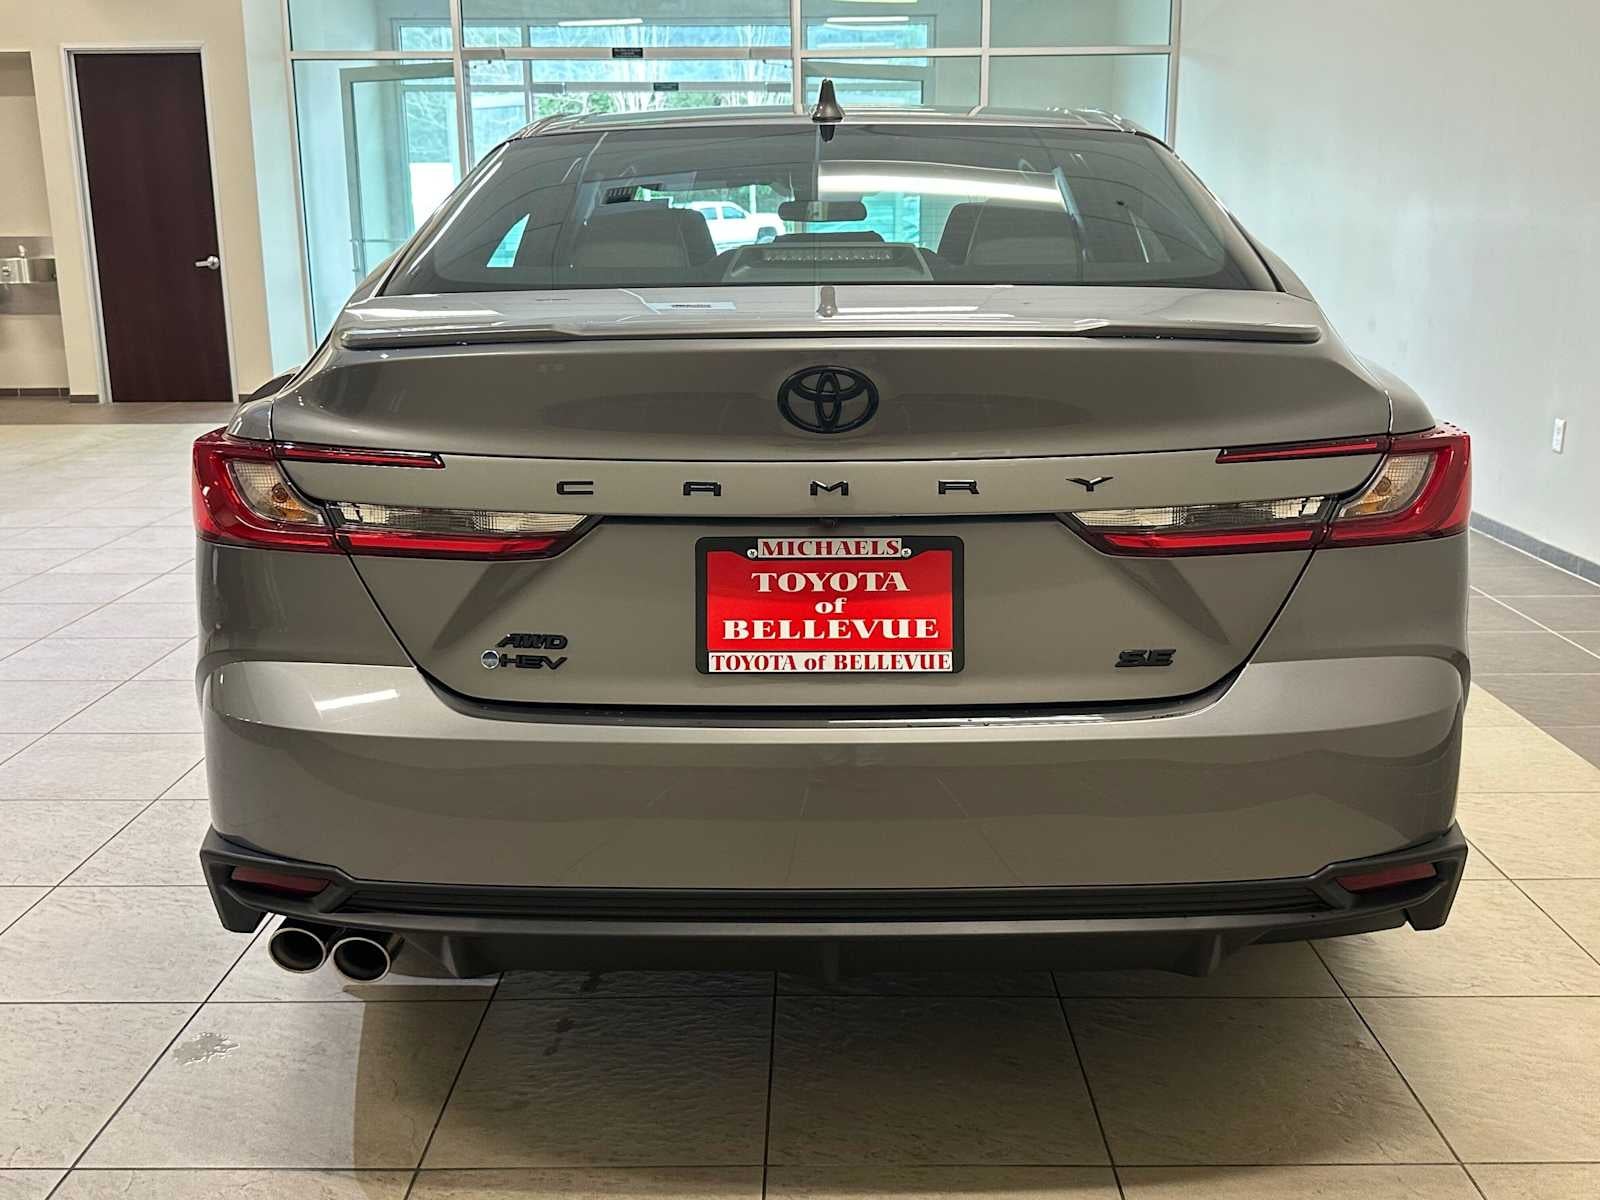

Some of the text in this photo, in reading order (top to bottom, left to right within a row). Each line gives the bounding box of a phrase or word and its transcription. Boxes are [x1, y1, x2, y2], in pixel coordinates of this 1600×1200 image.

[556, 475, 1114, 497] CAMRY
[761, 539, 901, 557] MICHAELS
[751, 571, 910, 592] TOYOTA
[814, 597, 847, 615] of
[722, 618, 939, 640] BELLEVUE
[495, 633, 568, 650] AWD
[500, 653, 568, 670] HEV
[711, 653, 951, 671] TOYOTA of BELLEVUE
[1114, 648, 1176, 668] SE
